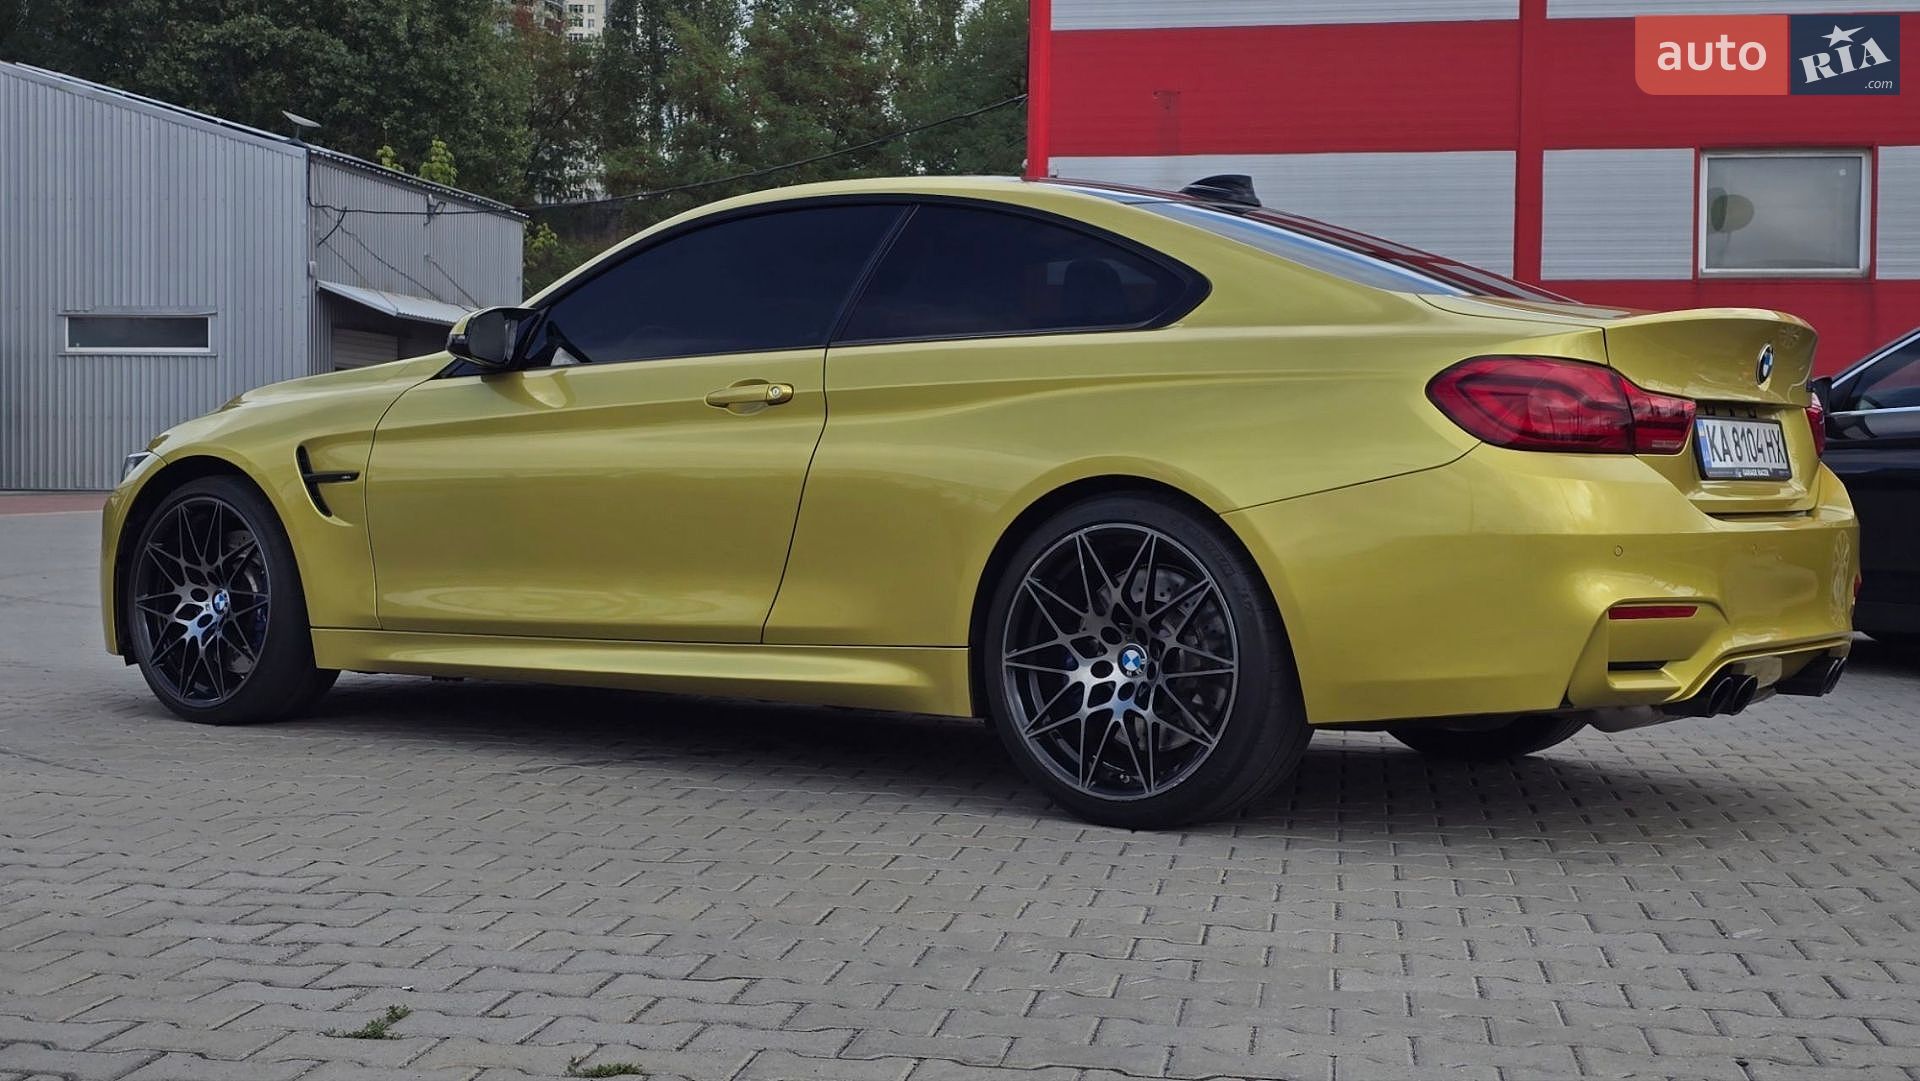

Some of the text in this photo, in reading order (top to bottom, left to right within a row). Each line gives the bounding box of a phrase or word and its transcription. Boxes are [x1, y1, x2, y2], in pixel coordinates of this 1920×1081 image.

[1706, 425, 1786, 464] KA 8104 HX
